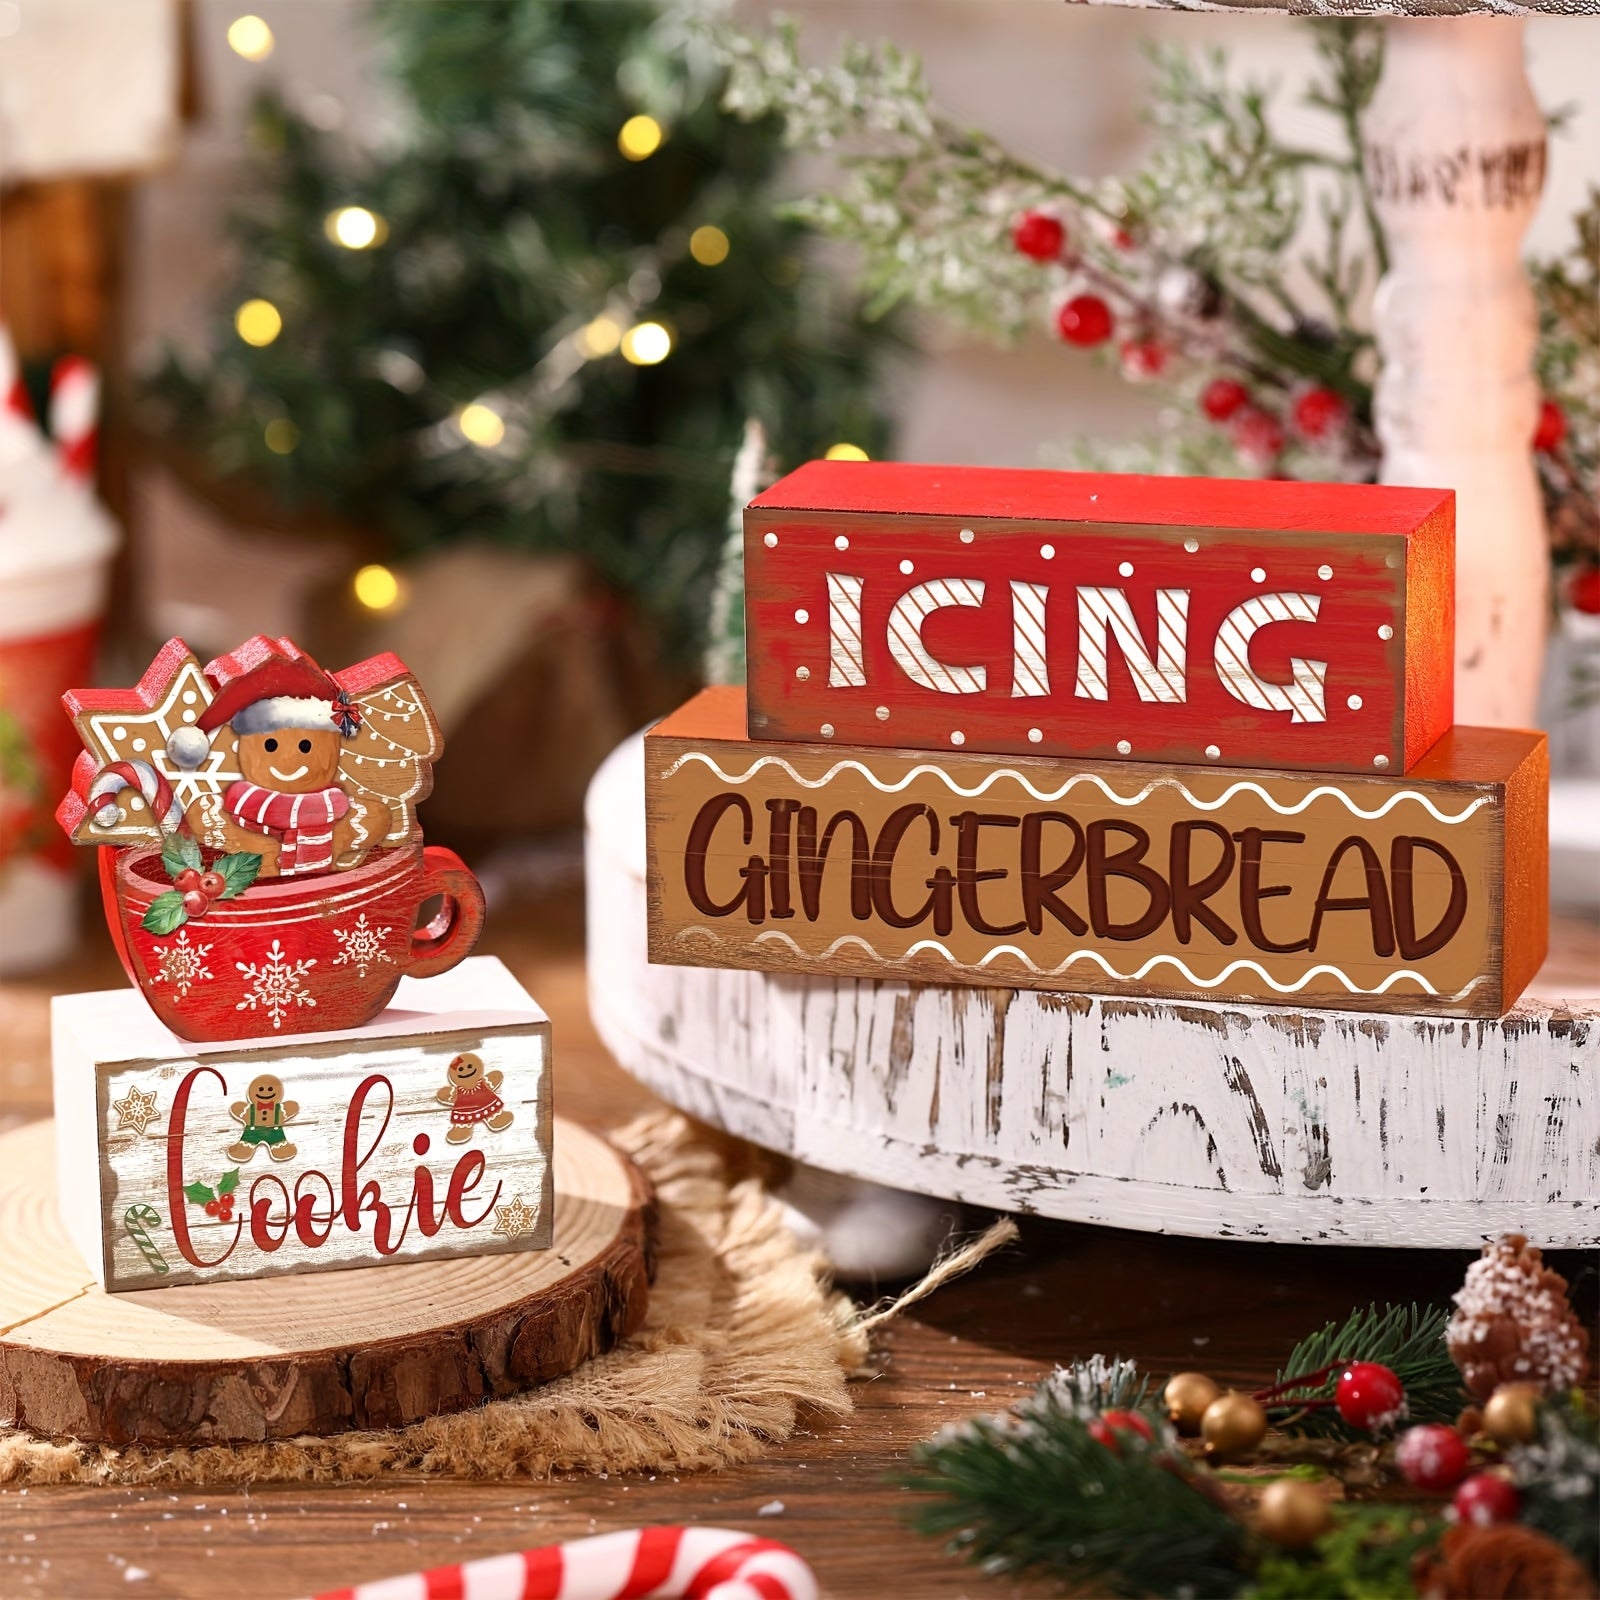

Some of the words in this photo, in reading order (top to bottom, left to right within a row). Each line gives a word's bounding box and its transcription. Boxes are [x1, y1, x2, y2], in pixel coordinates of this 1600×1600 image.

[826, 572, 1328, 724] ICING
[684, 793, 1468, 961] GINGERBREAD
[167, 1066, 502, 1268] Cookie
